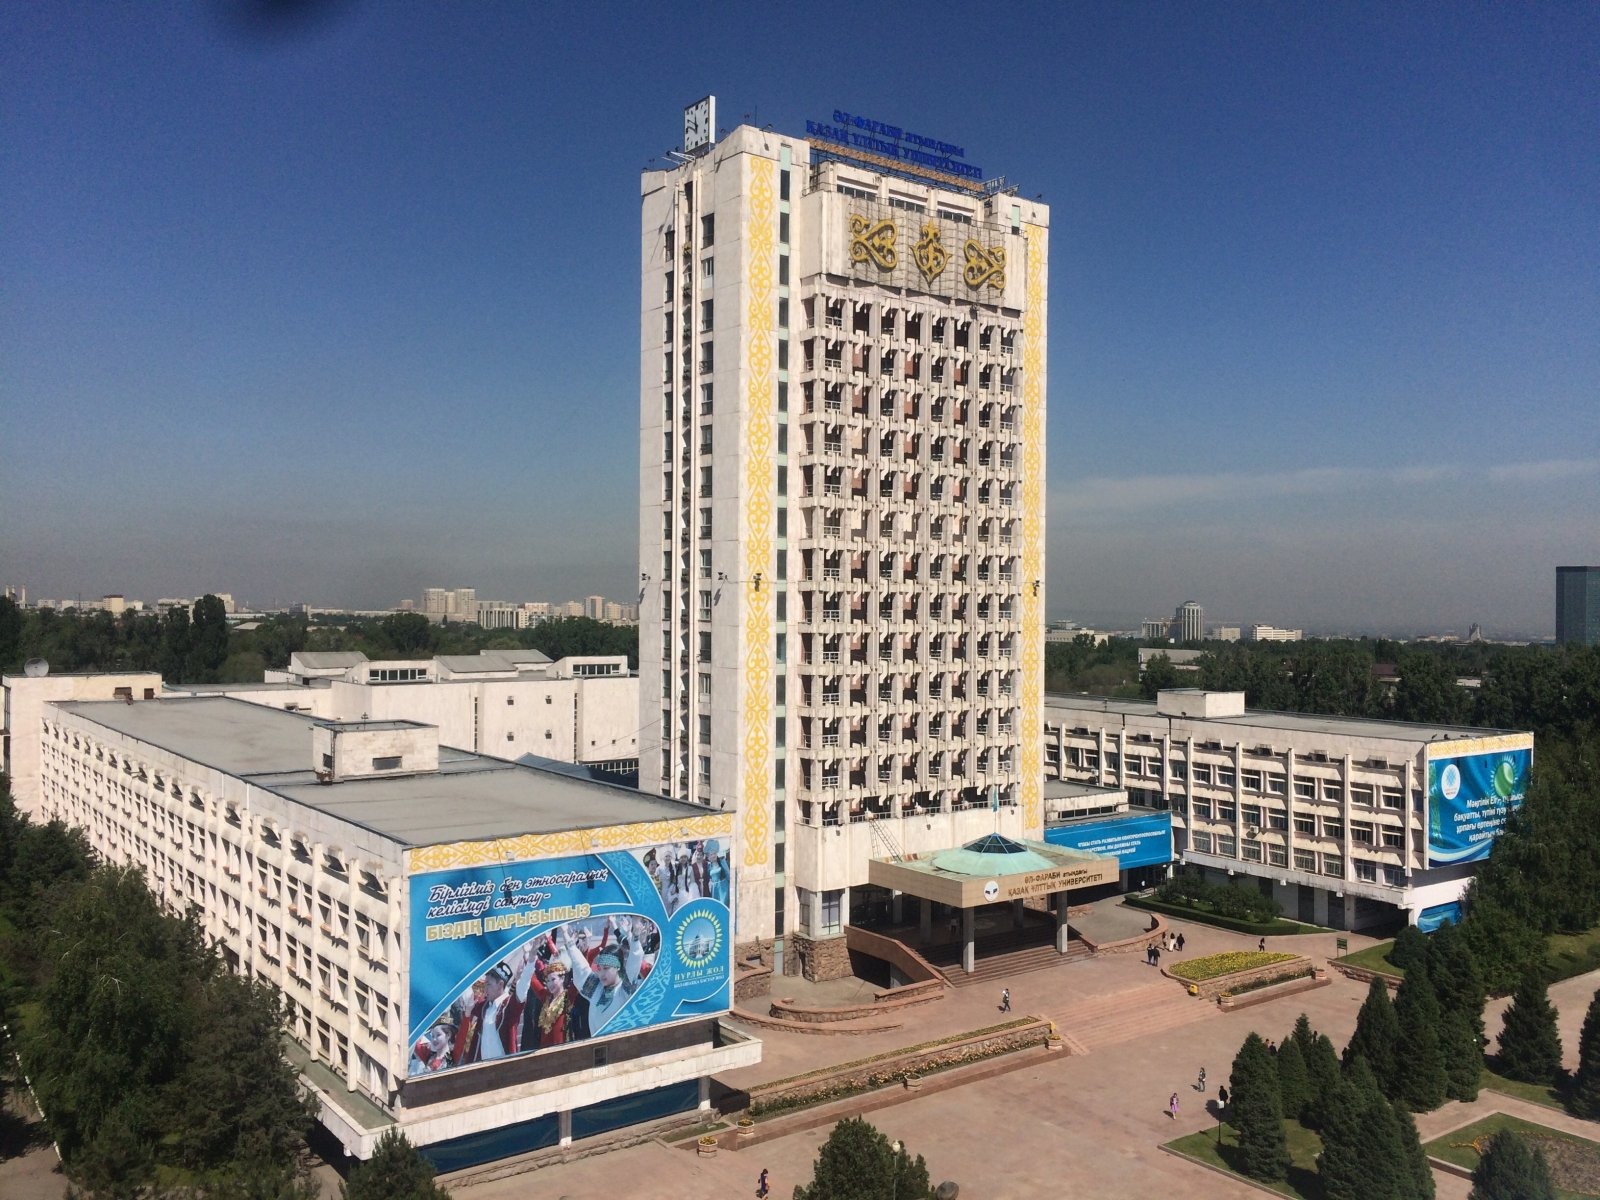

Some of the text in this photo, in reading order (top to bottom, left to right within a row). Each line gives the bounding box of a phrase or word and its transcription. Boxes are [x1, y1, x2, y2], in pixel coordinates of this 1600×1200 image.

[500, 876, 521, 893] бен
[426, 903, 592, 942] БІЗДІҢ ПАРЫЗЫМЫЗ
